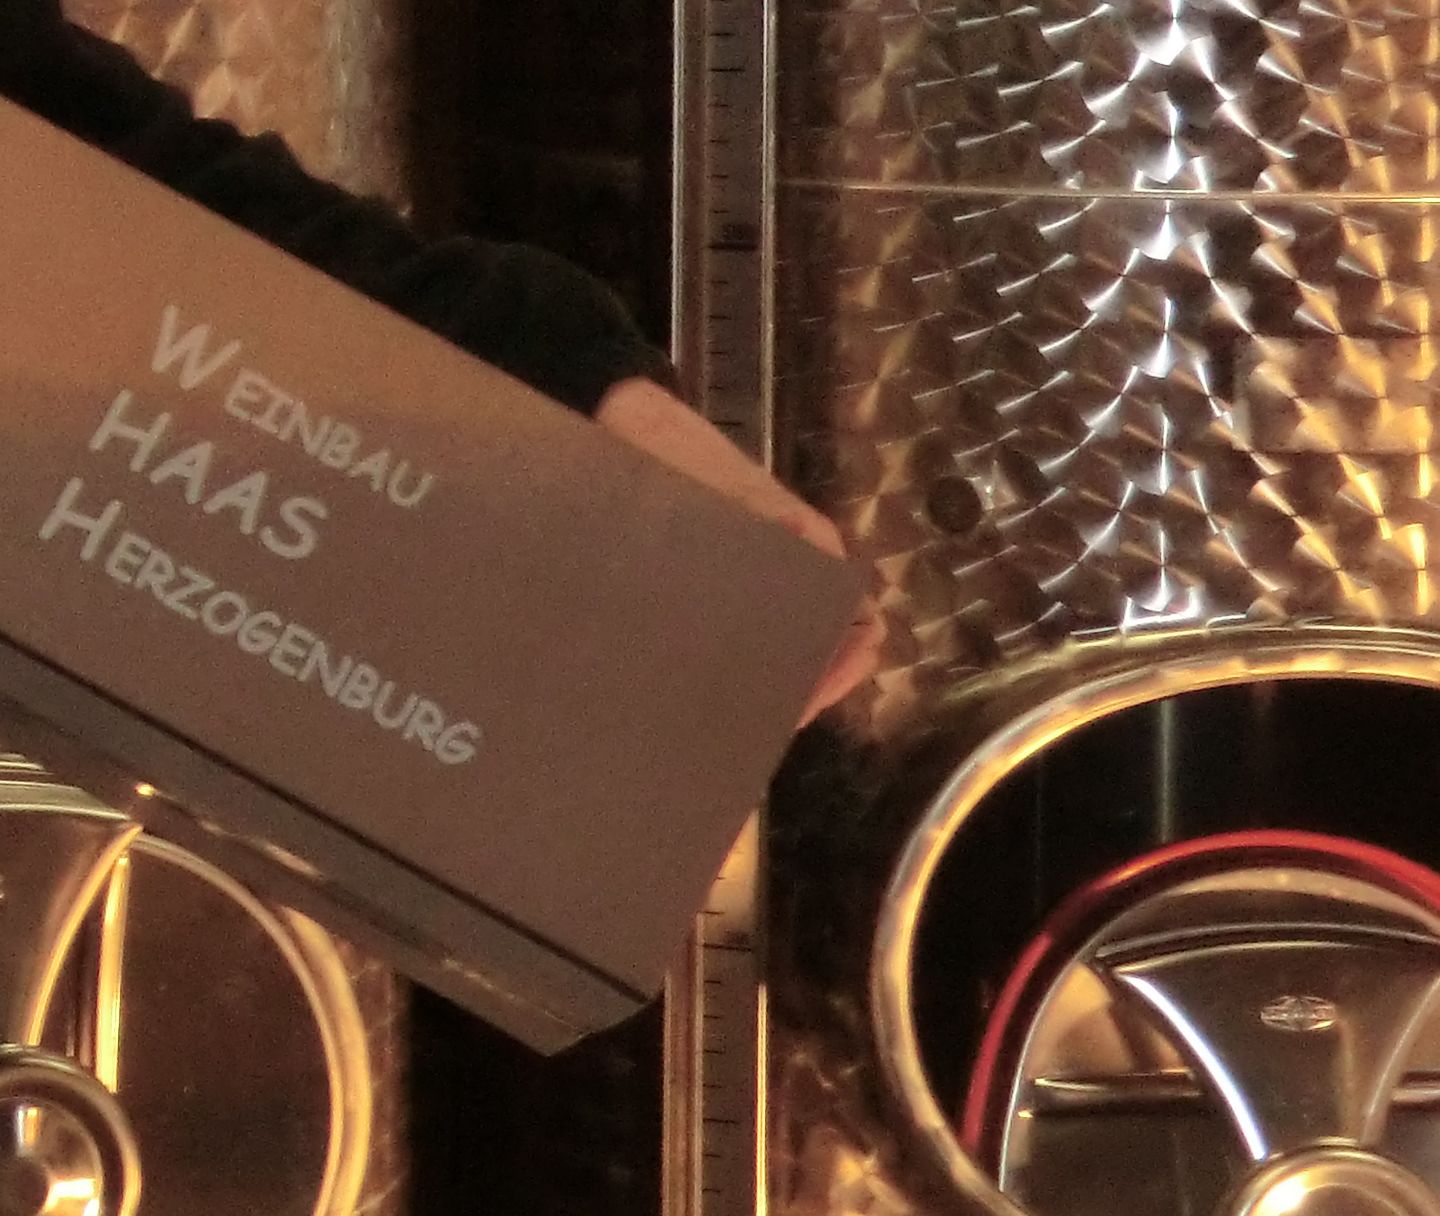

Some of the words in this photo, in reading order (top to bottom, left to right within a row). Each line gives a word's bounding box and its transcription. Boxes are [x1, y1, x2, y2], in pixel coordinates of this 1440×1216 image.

[88, 389, 329, 560] HAAS
[150, 304, 433, 508] WEINBAU
[37, 477, 483, 766] HERZOGENBURG
